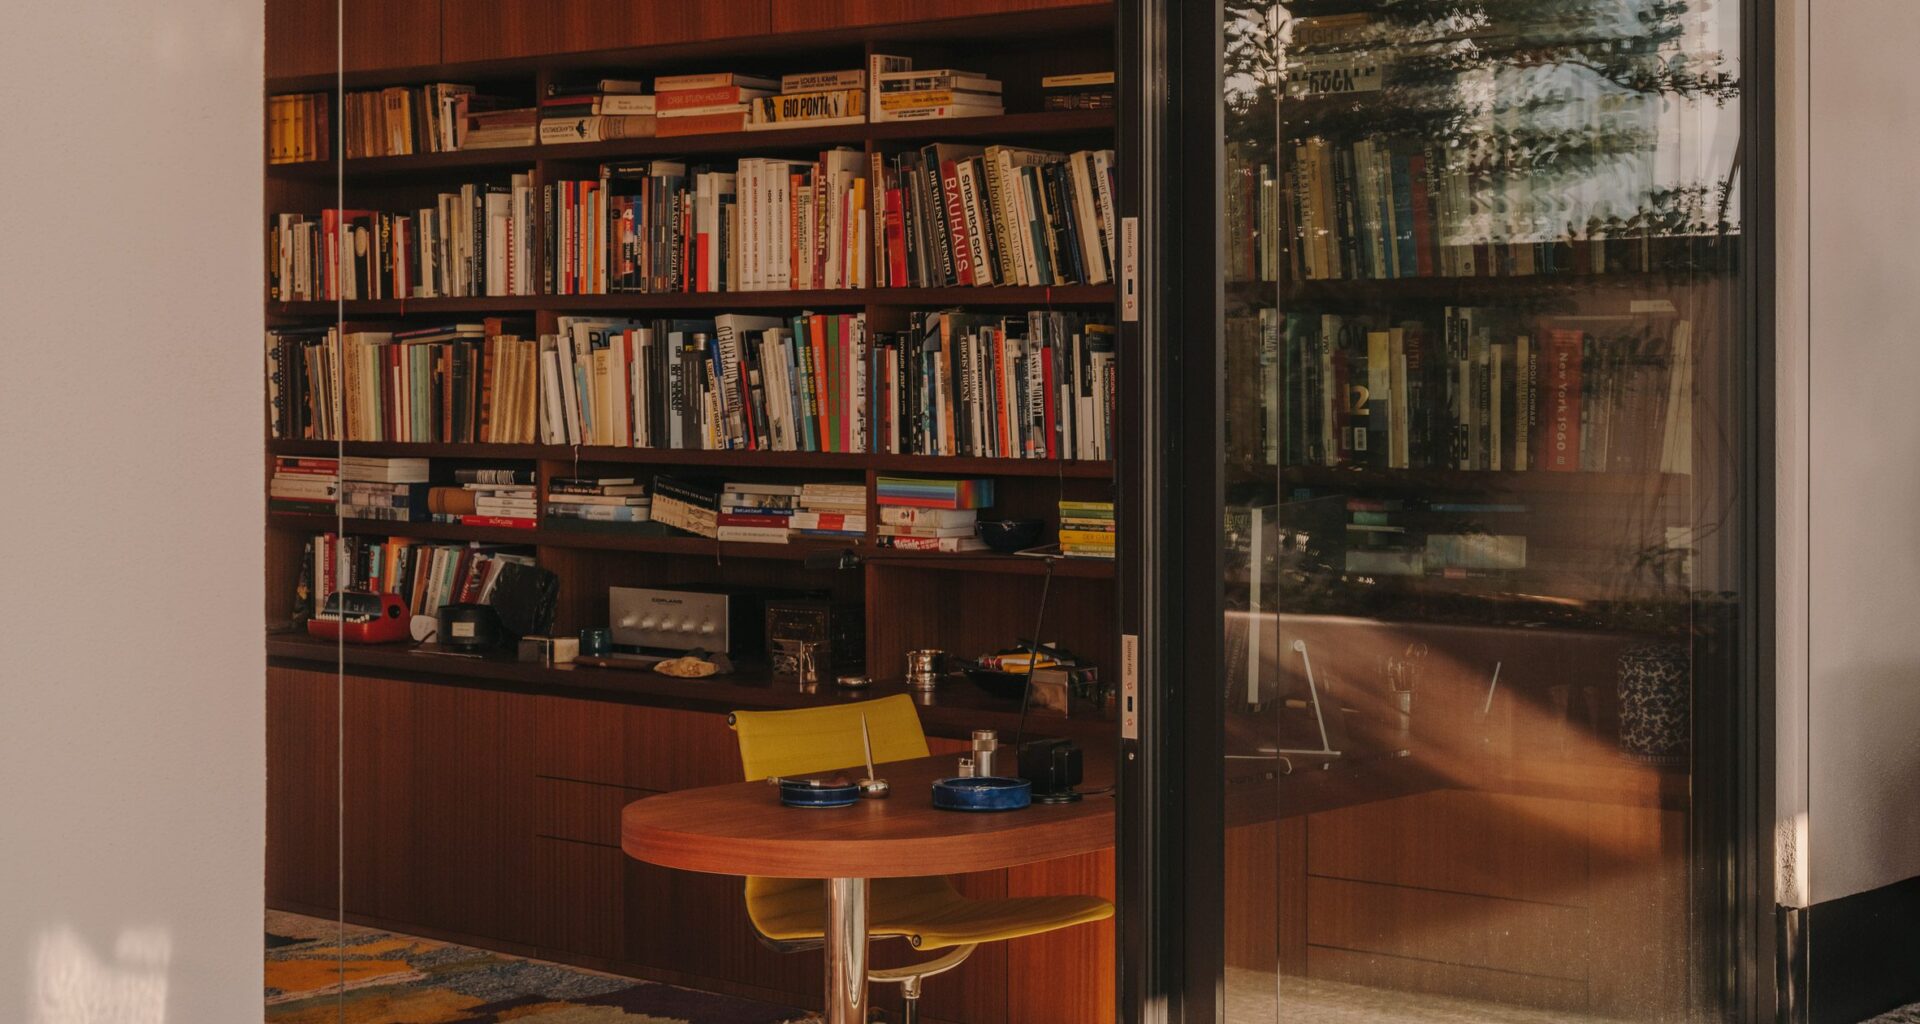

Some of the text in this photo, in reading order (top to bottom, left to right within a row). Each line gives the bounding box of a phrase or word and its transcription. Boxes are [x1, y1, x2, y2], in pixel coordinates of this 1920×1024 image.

[821, 74, 838, 82] KAHN
[783, 96, 829, 118] GIO PONTI
[929, 170, 938, 188] DIE
[622, 208, 634, 221] 4
[932, 187, 944, 220] VILLEN
[985, 159, 1013, 273] Irish houses & castles
[1100, 195, 1110, 211] des
[937, 220, 947, 240] DES
[943, 176, 969, 273] BAUHAUS
[960, 173, 983, 267] Das Bauhaus
[940, 241, 952, 275] VENETO
[1322, 334, 1330, 355] OMA
[718, 326, 741, 414] DAVID CHIPPERFIELD
[960, 334, 971, 402] KNOBELSDORFF
[1350, 384, 1371, 416] 2
[1529, 354, 1538, 427] RUDOLF SCHWARZ
[1556, 352, 1569, 451] New York 1960
[710, 392, 723, 438] CORBUSIER
[716, 437, 724, 450] LE
